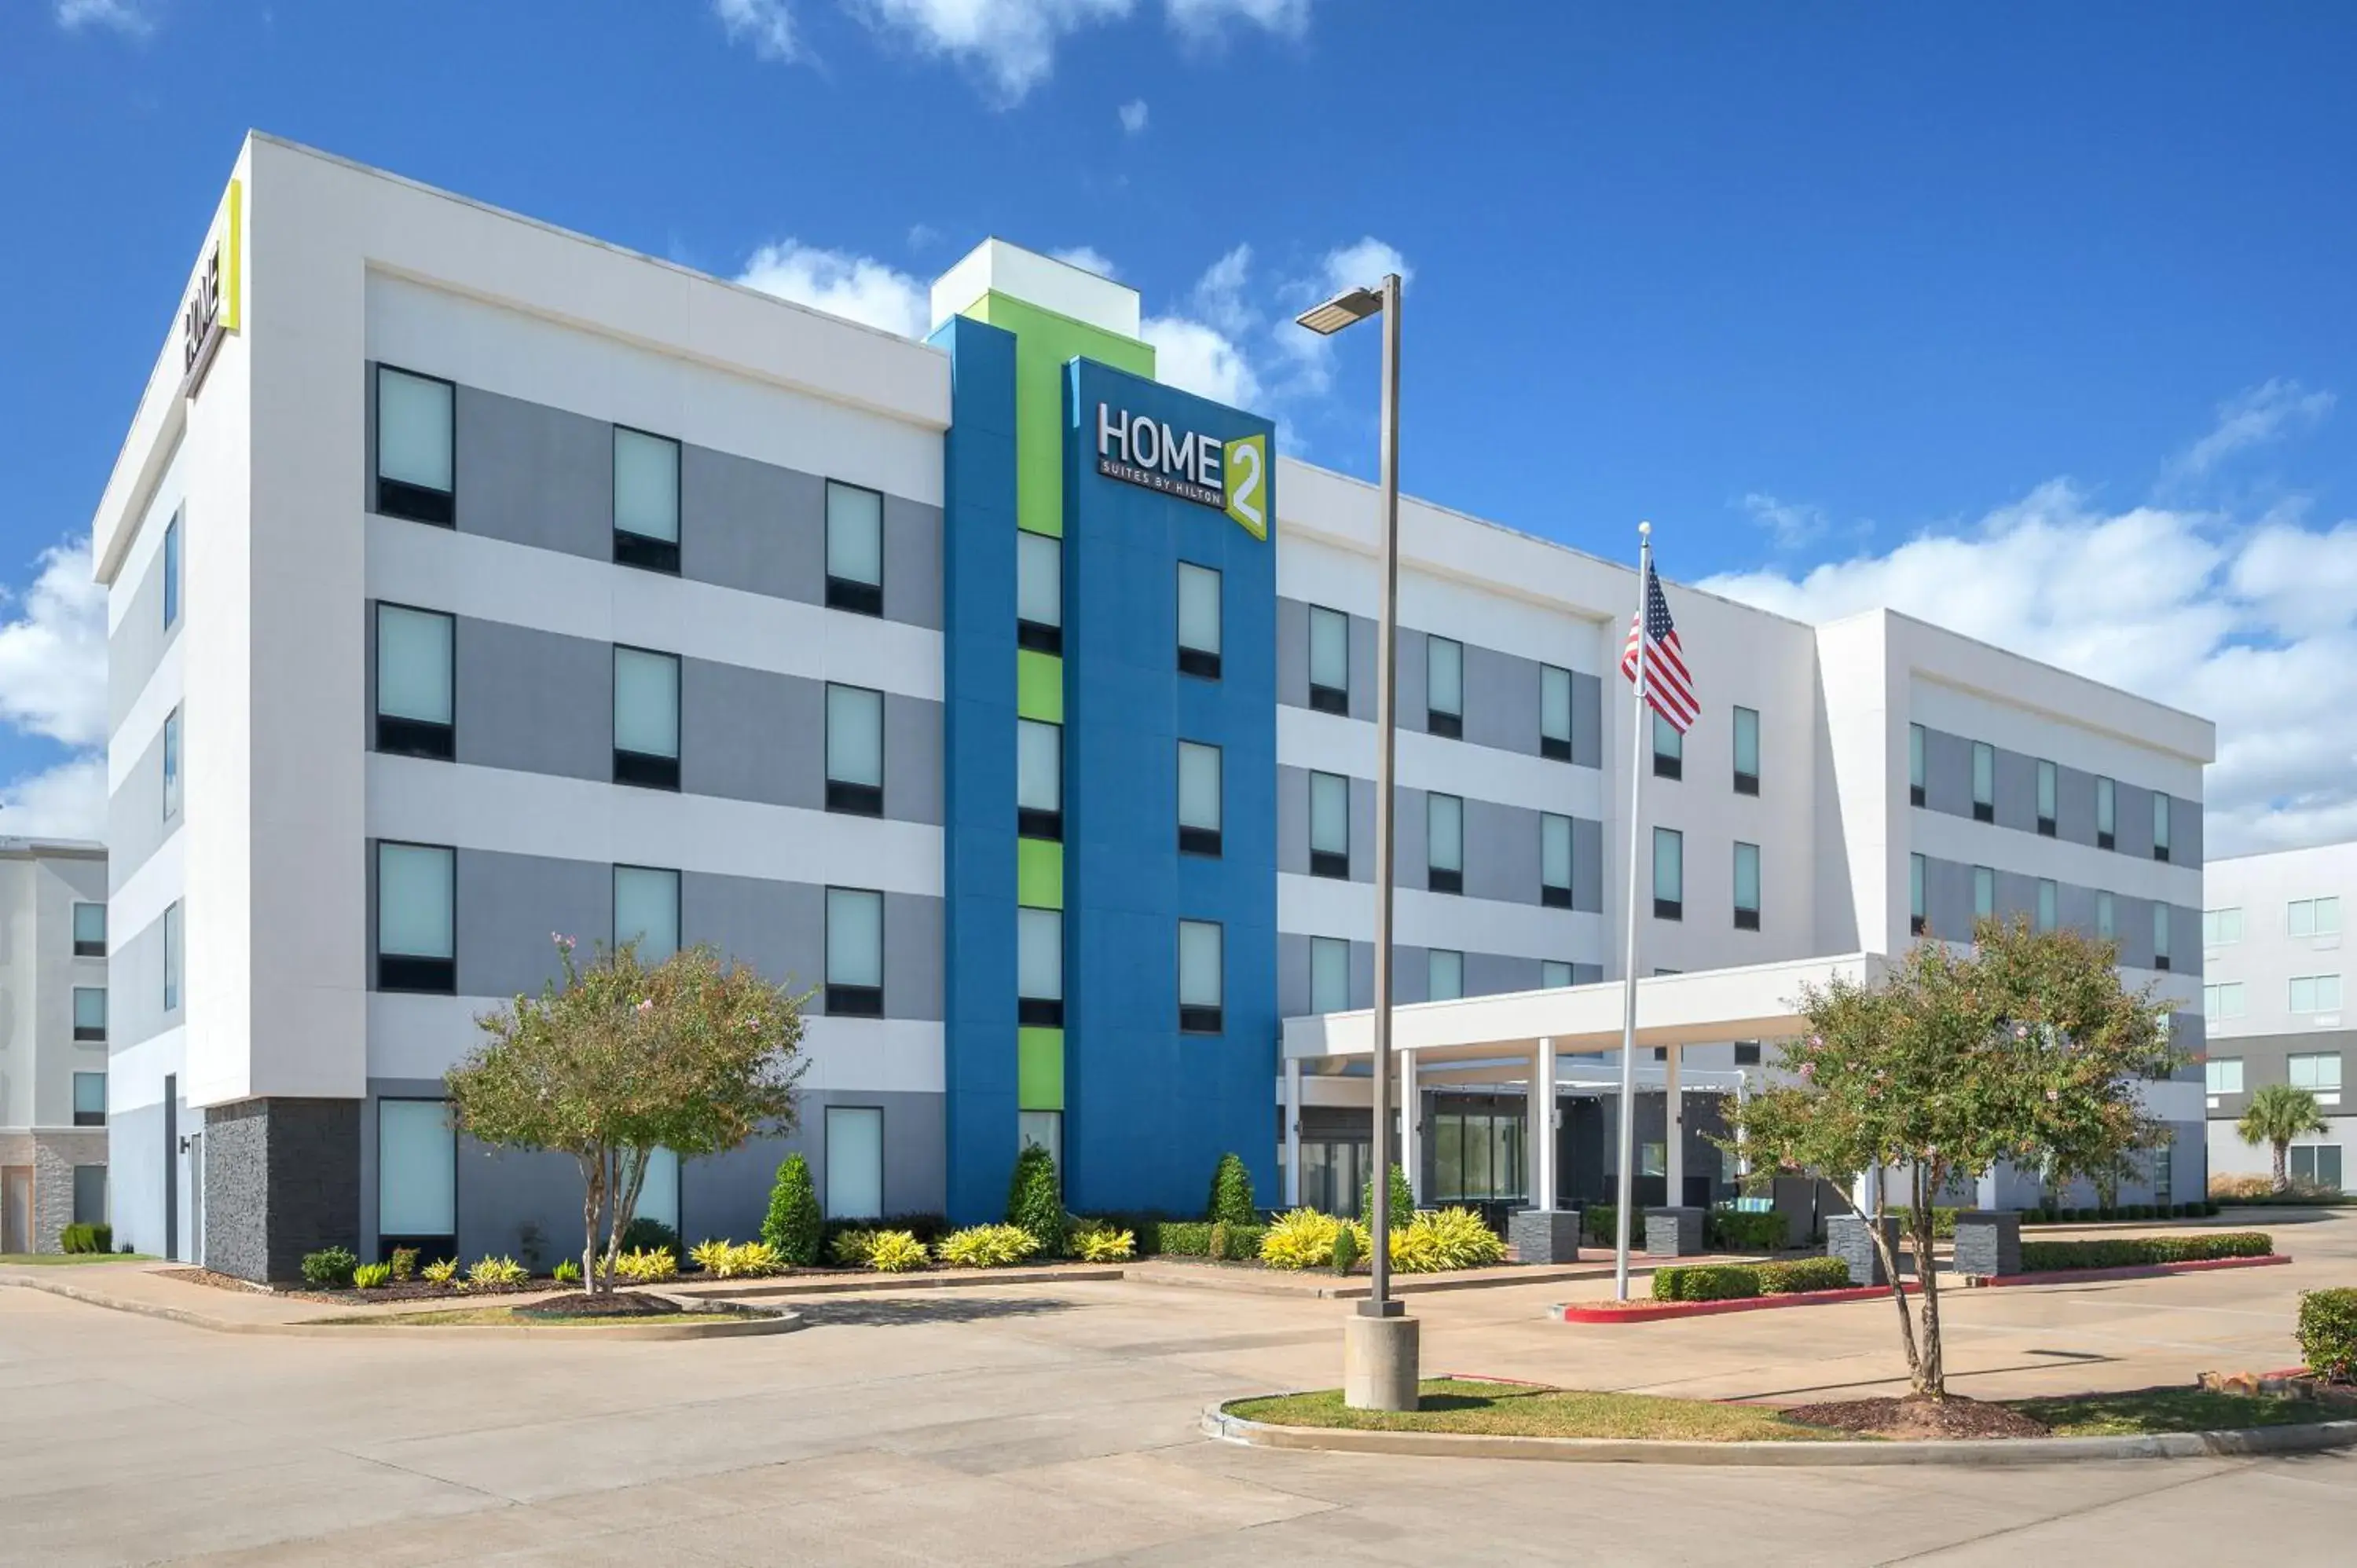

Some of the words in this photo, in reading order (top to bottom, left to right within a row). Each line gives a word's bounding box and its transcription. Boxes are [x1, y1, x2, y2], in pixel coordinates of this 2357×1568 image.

[1098, 402, 1222, 489] HOME
[1233, 444, 1261, 526] 2
[1103, 461, 1149, 483] SUITES
[1155, 477, 1170, 489] BY
[1176, 482, 1220, 504] HILTON
